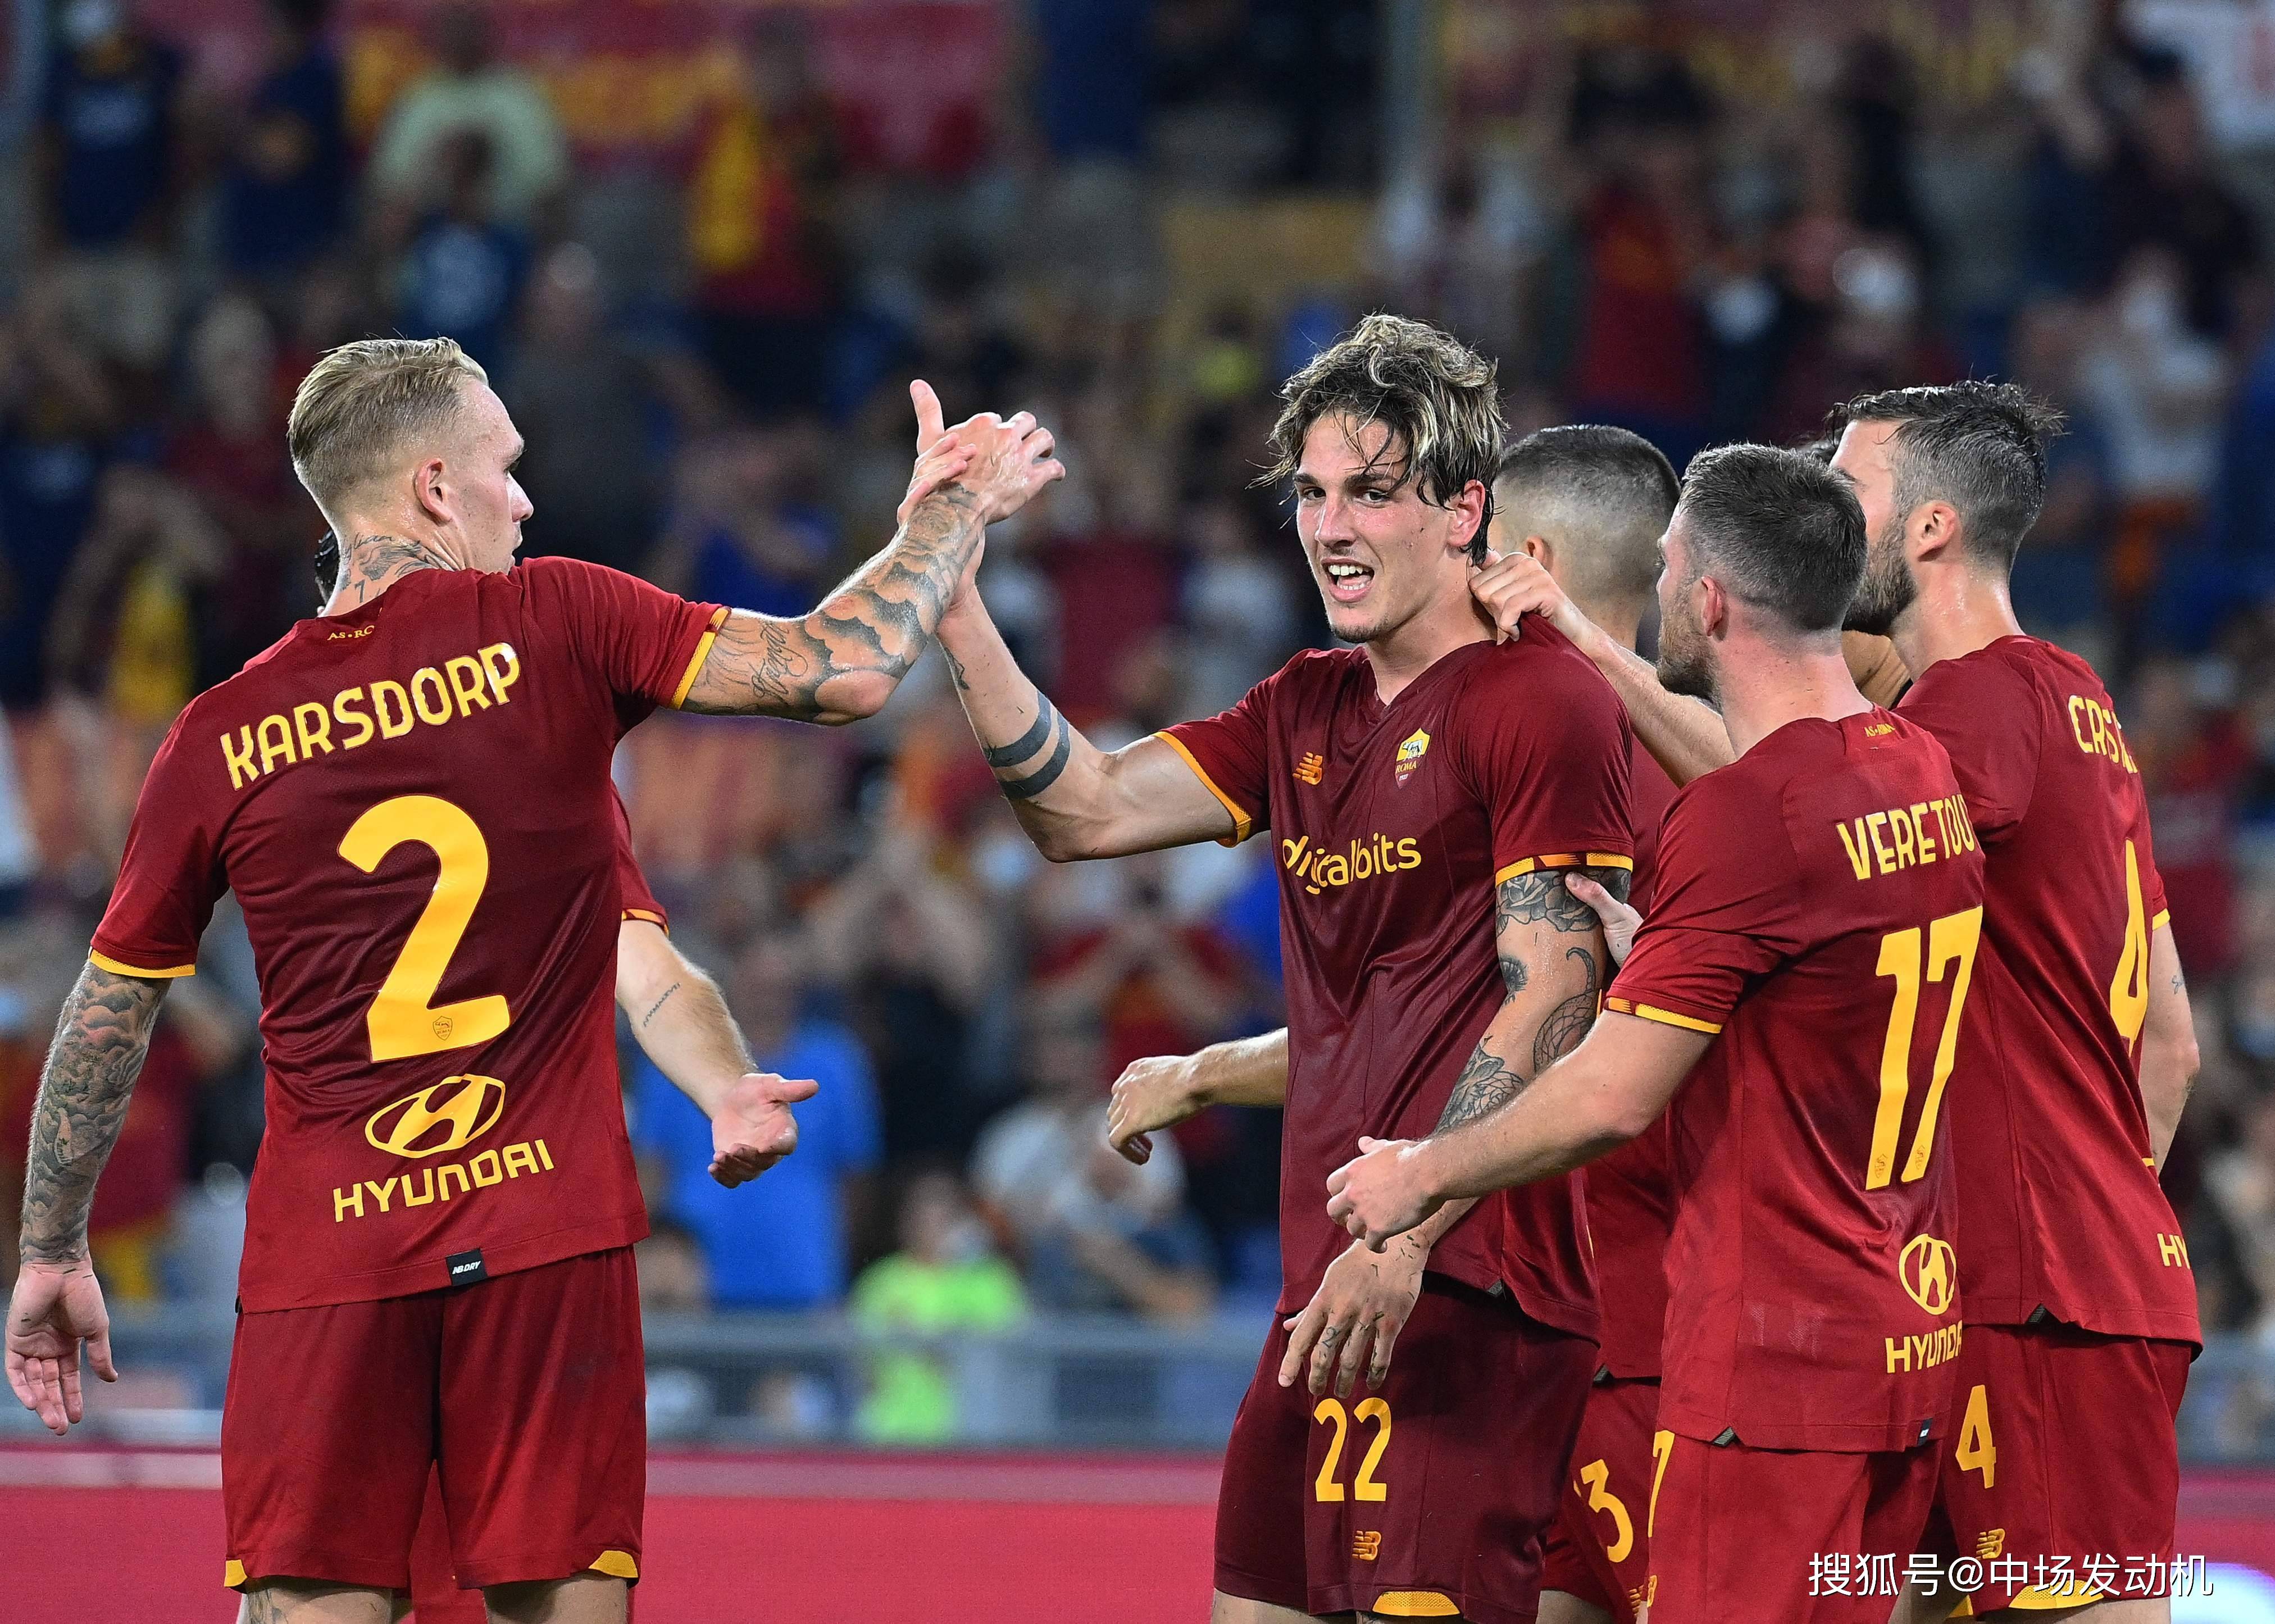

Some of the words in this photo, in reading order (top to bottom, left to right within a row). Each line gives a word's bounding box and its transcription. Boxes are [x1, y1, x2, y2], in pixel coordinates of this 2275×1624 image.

[220, 642, 521, 791] KARSDORP
[1395, 760, 1417, 774] ROMA
[1836, 793, 1976, 880] VERETOU
[338, 795, 511, 1063] 2
[2109, 839, 2149, 1058] 4
[1866, 905, 1983, 1191] 17
[333, 1138, 555, 1223] HYUNDAI
[1313, 1397, 1392, 1502] 22
[1955, 1384, 1996, 1490] 4
